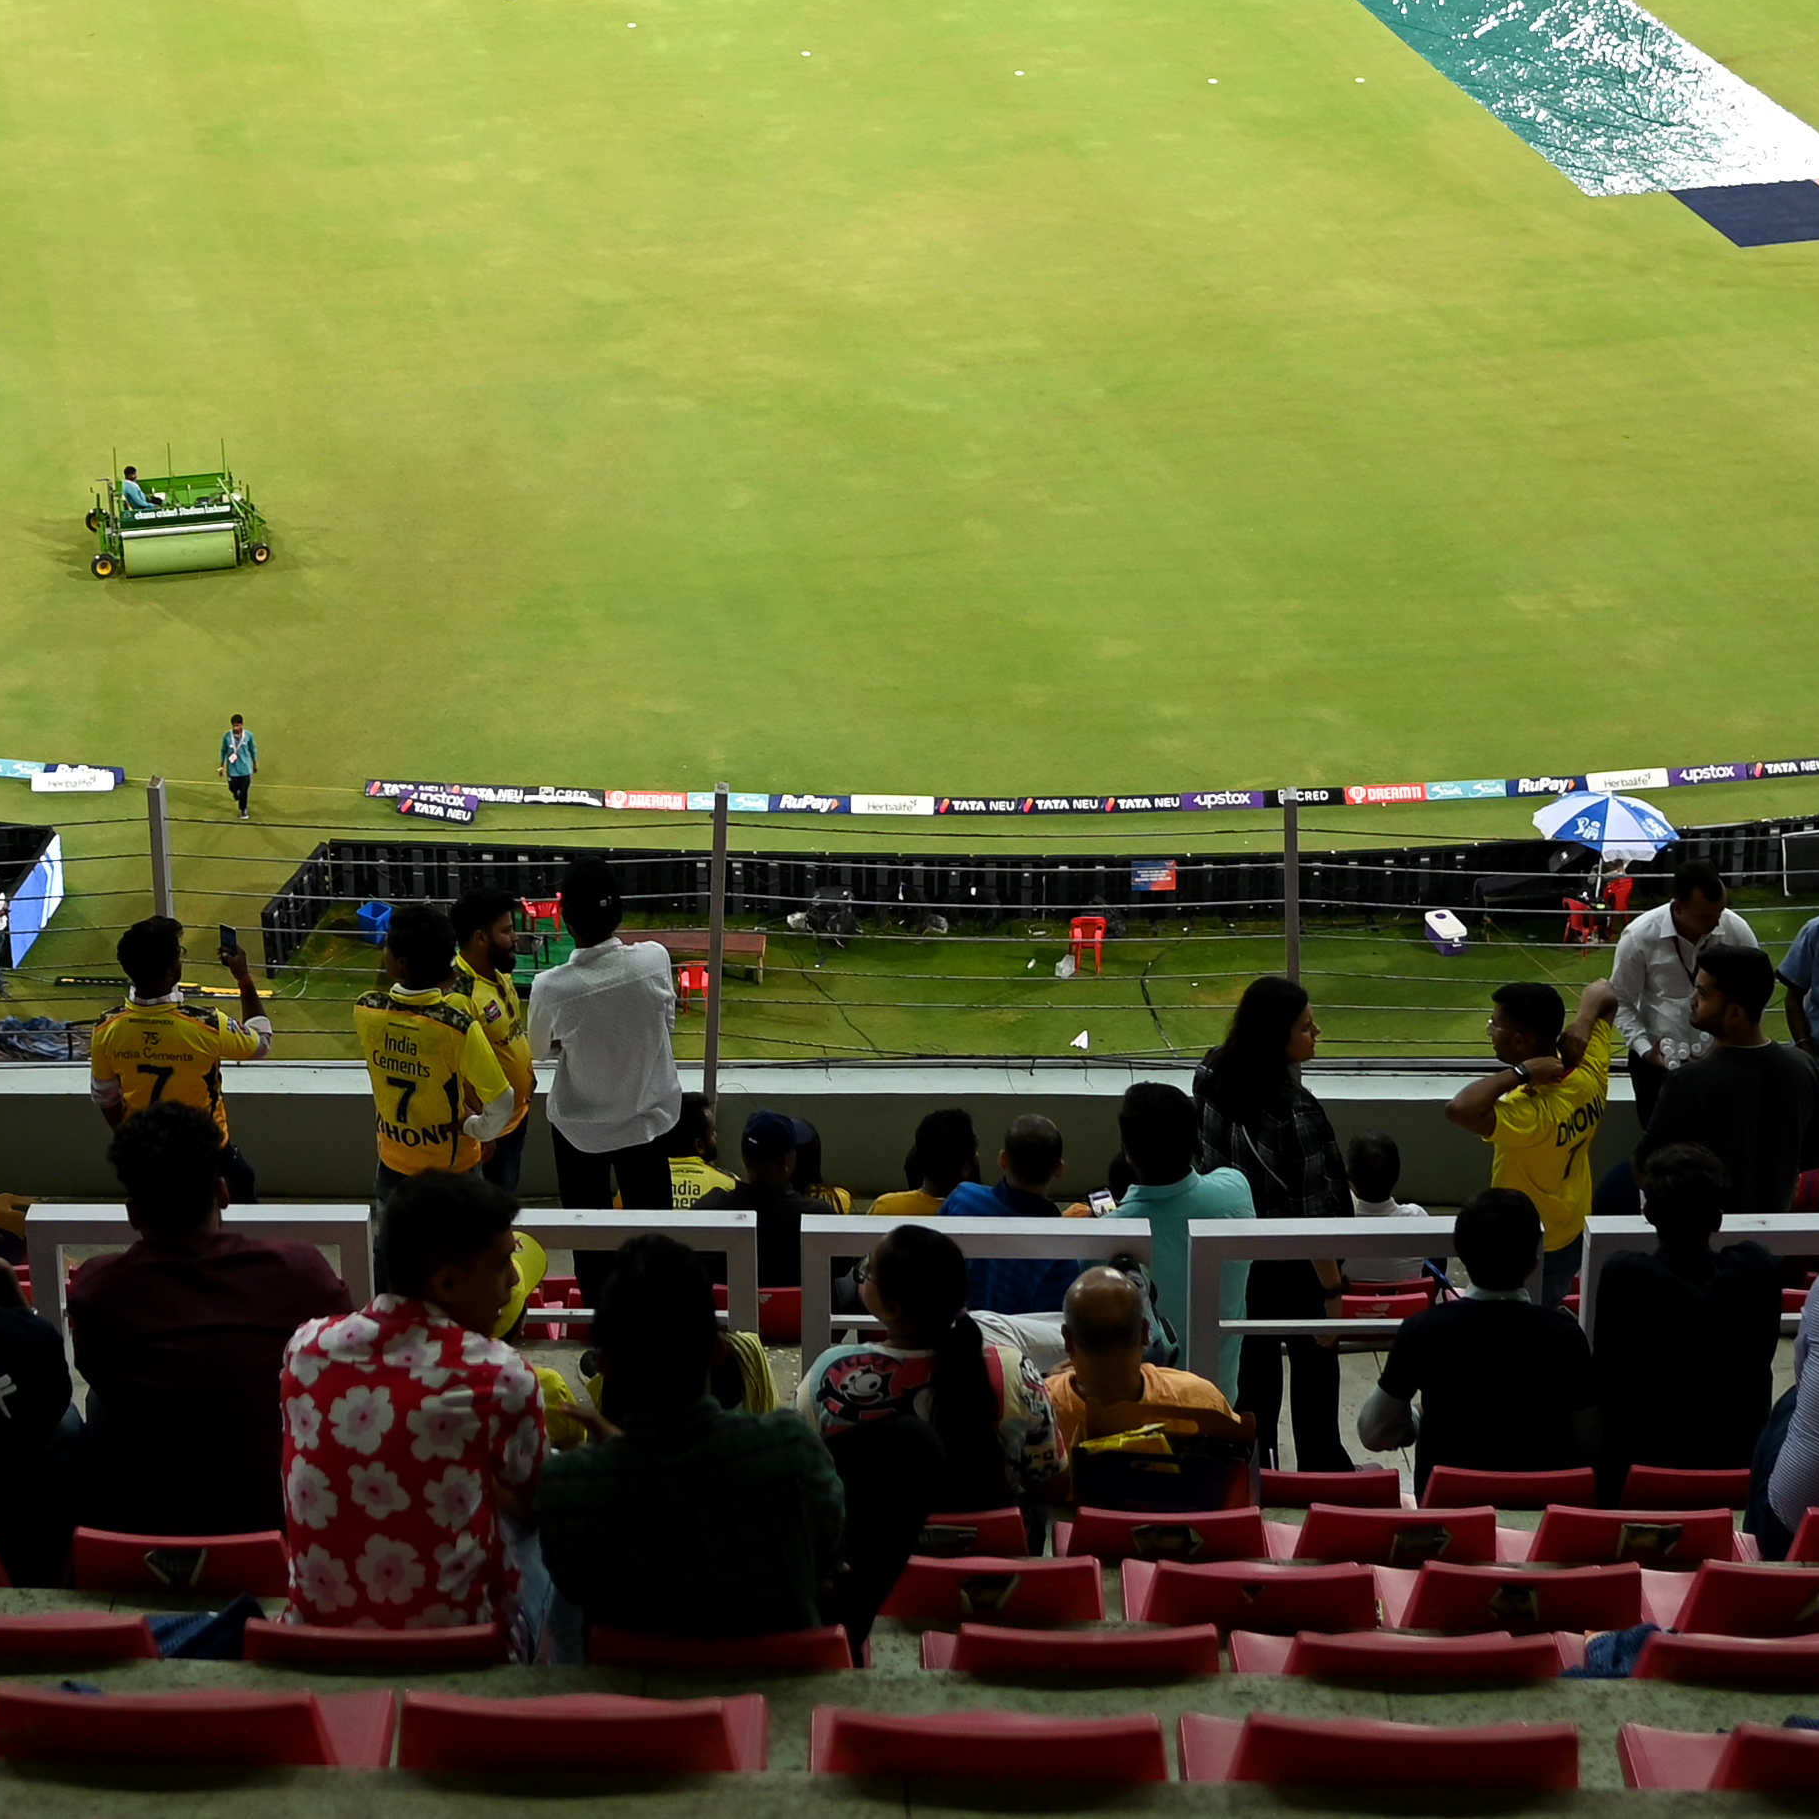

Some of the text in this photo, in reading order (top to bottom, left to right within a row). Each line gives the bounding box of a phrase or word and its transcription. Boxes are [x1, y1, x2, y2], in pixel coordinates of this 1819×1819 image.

[1680, 765, 1735, 783] upstox
[1765, 761, 1797, 774] TATA
[47, 775, 97, 789] Herbalife
[1518, 776, 1570, 794] RuPay
[1603, 772, 1652, 788] Herbalife
[498, 788, 524, 801] NEU
[1193, 790, 1251, 808] upstox
[1297, 789, 1329, 802] CRED
[1368, 785, 1422, 800] DREAM11
[628, 793, 683, 810] DREAM11
[779, 794, 832, 813] RuPay
[867, 798, 918, 812] Herbalife
[952, 799, 1016, 811] TATA NEU
[1035, 798, 1099, 811] TATA NEU
[1117, 797, 1180, 810] TATA NEU
[413, 802, 472, 821] TATA NEU
[142, 1031, 159, 1046] 75
[384, 1032, 418, 1057] India
[113, 1047, 194, 1062] India Cements
[372, 1050, 431, 1079] Cements
[137, 1064, 174, 1104] 7
[386, 1075, 418, 1124] 7
[1556, 1094, 1605, 1148] DHONI
[672, 1180, 701, 1196] ndia
